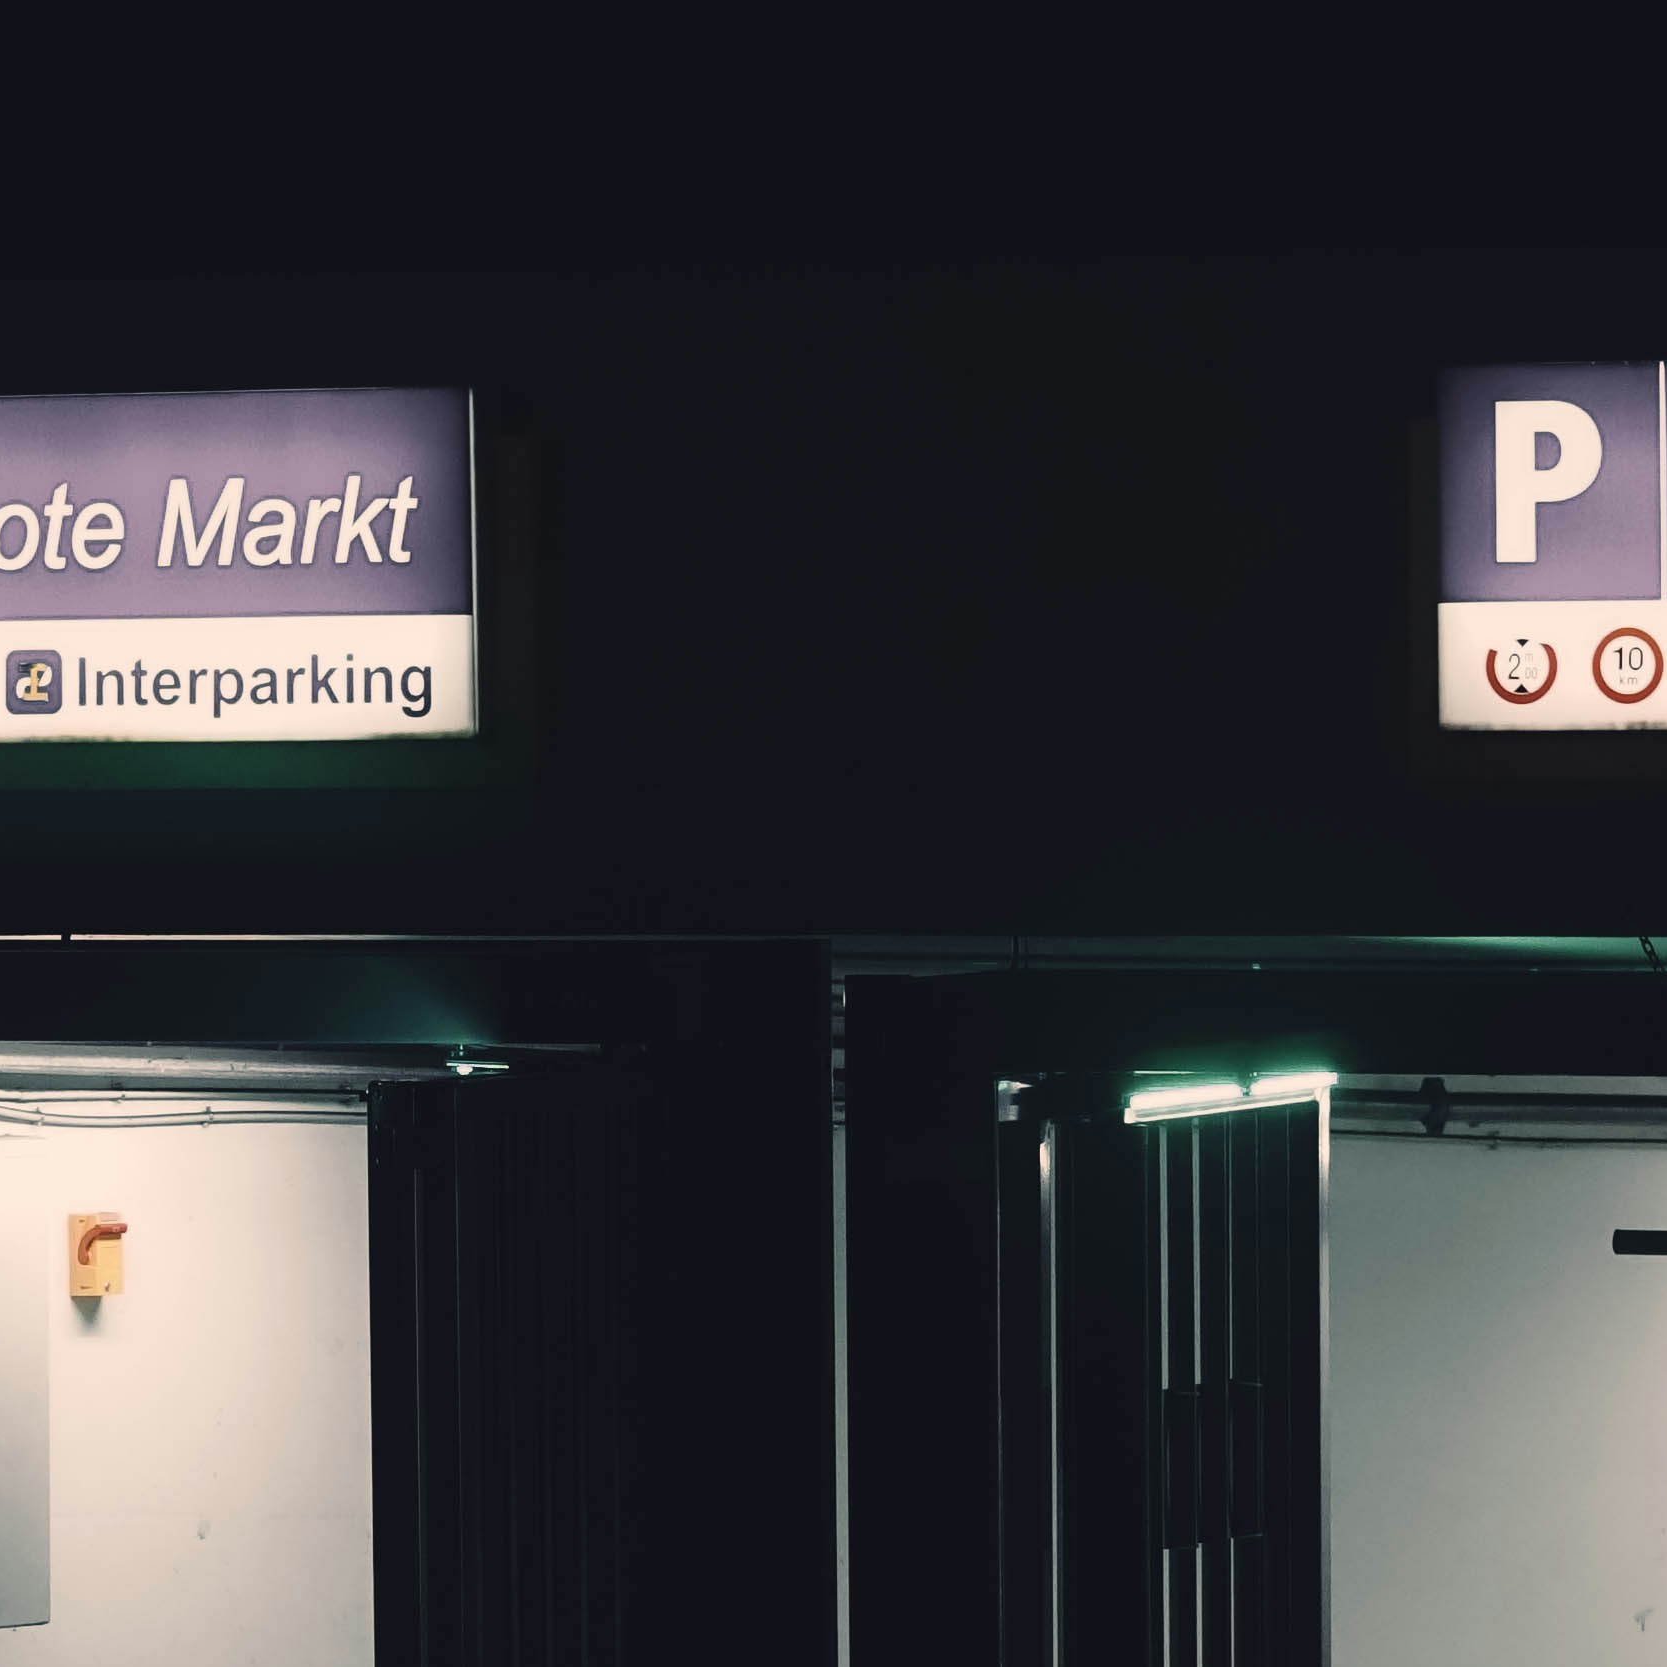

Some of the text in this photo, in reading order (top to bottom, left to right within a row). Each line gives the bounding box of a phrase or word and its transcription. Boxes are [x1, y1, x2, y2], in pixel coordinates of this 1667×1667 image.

[156, 474, 419, 568] Markt
[1495, 400, 1602, 563] P
[77, 653, 433, 719] Interparking
[1612, 646, 1644, 671] 10
